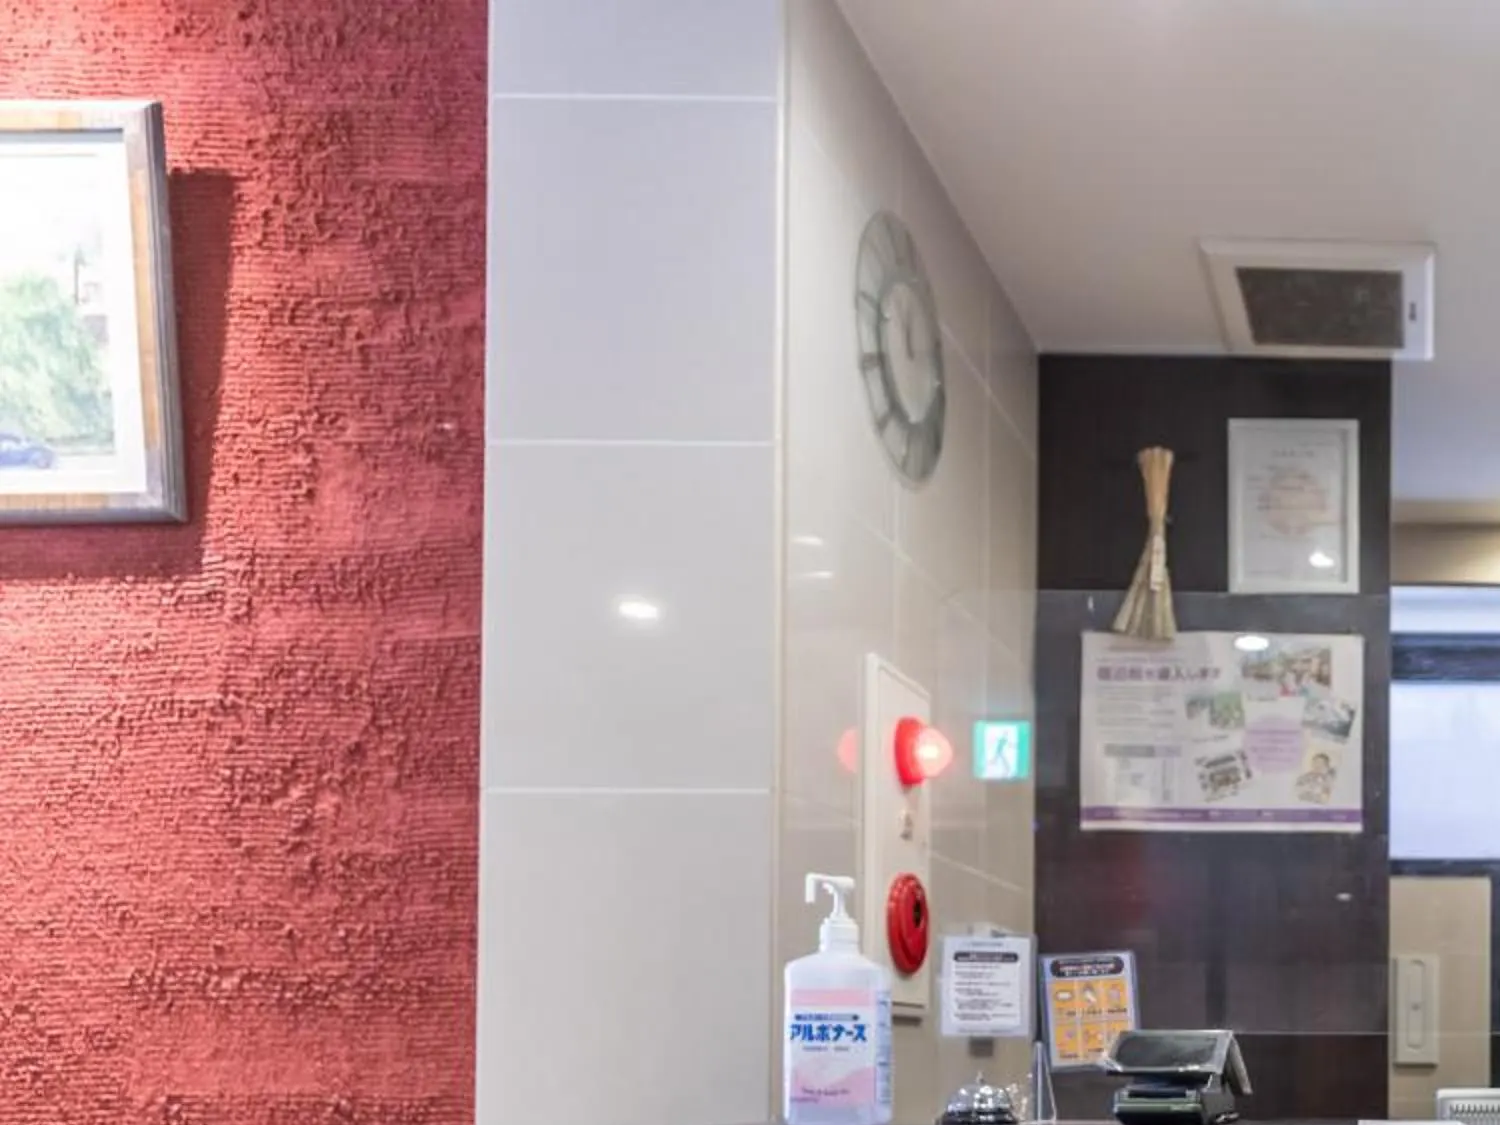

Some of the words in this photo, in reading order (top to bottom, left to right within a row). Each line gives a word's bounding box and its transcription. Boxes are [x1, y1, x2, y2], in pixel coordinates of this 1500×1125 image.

[790, 1024, 867, 1042] アルボナース
